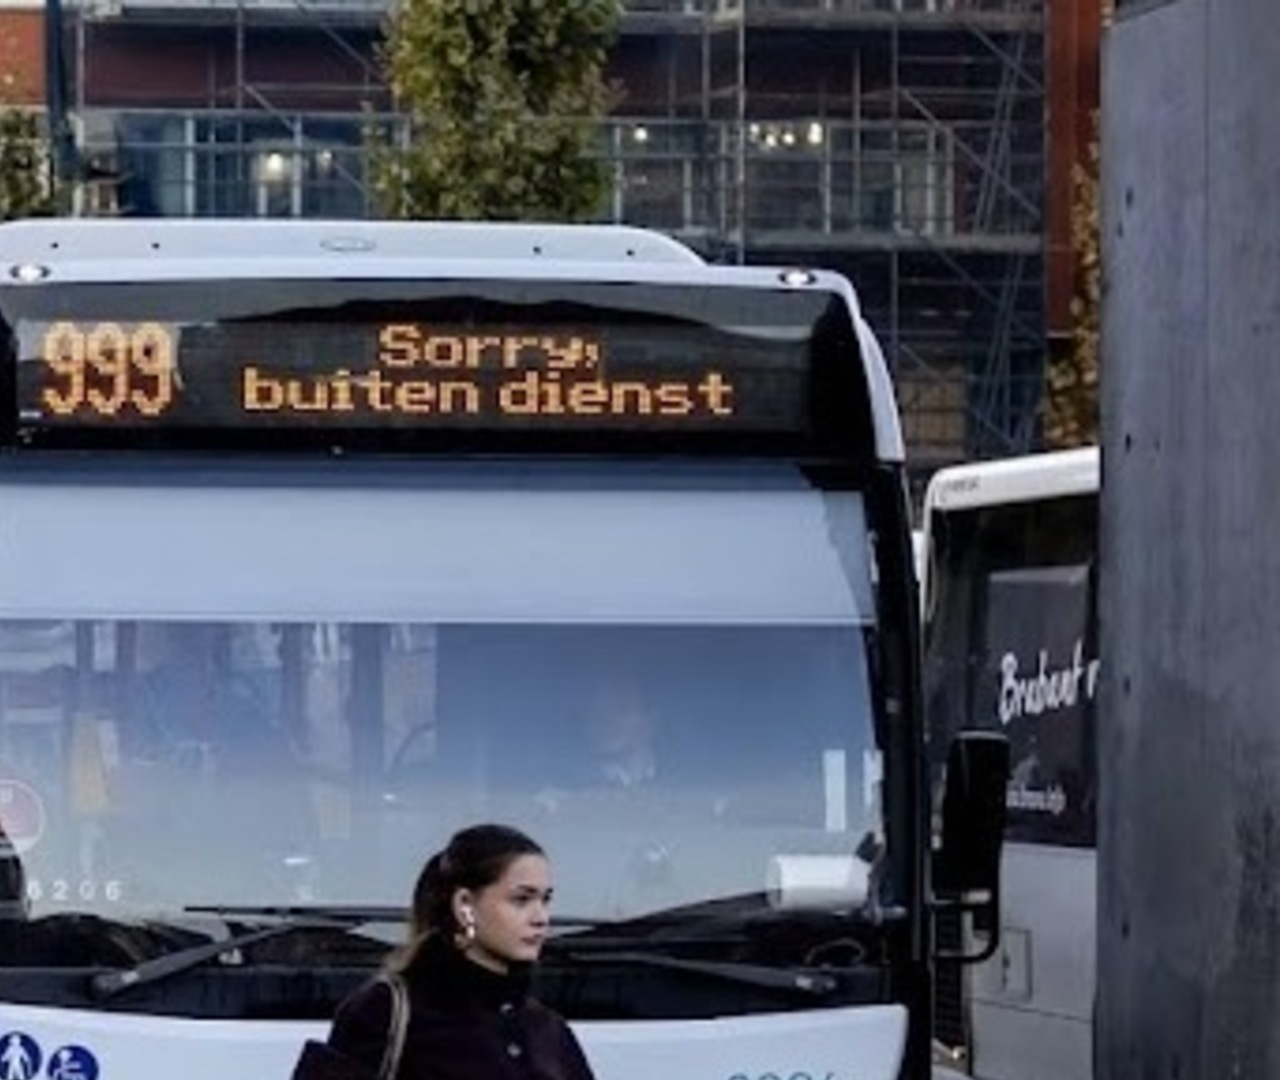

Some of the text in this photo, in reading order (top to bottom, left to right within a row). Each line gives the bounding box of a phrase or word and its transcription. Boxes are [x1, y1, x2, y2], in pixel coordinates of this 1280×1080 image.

[43, 321, 172, 415] 999
[379, 324, 599, 369] Sorry,
[243, 367, 734, 415] buiten dienst
